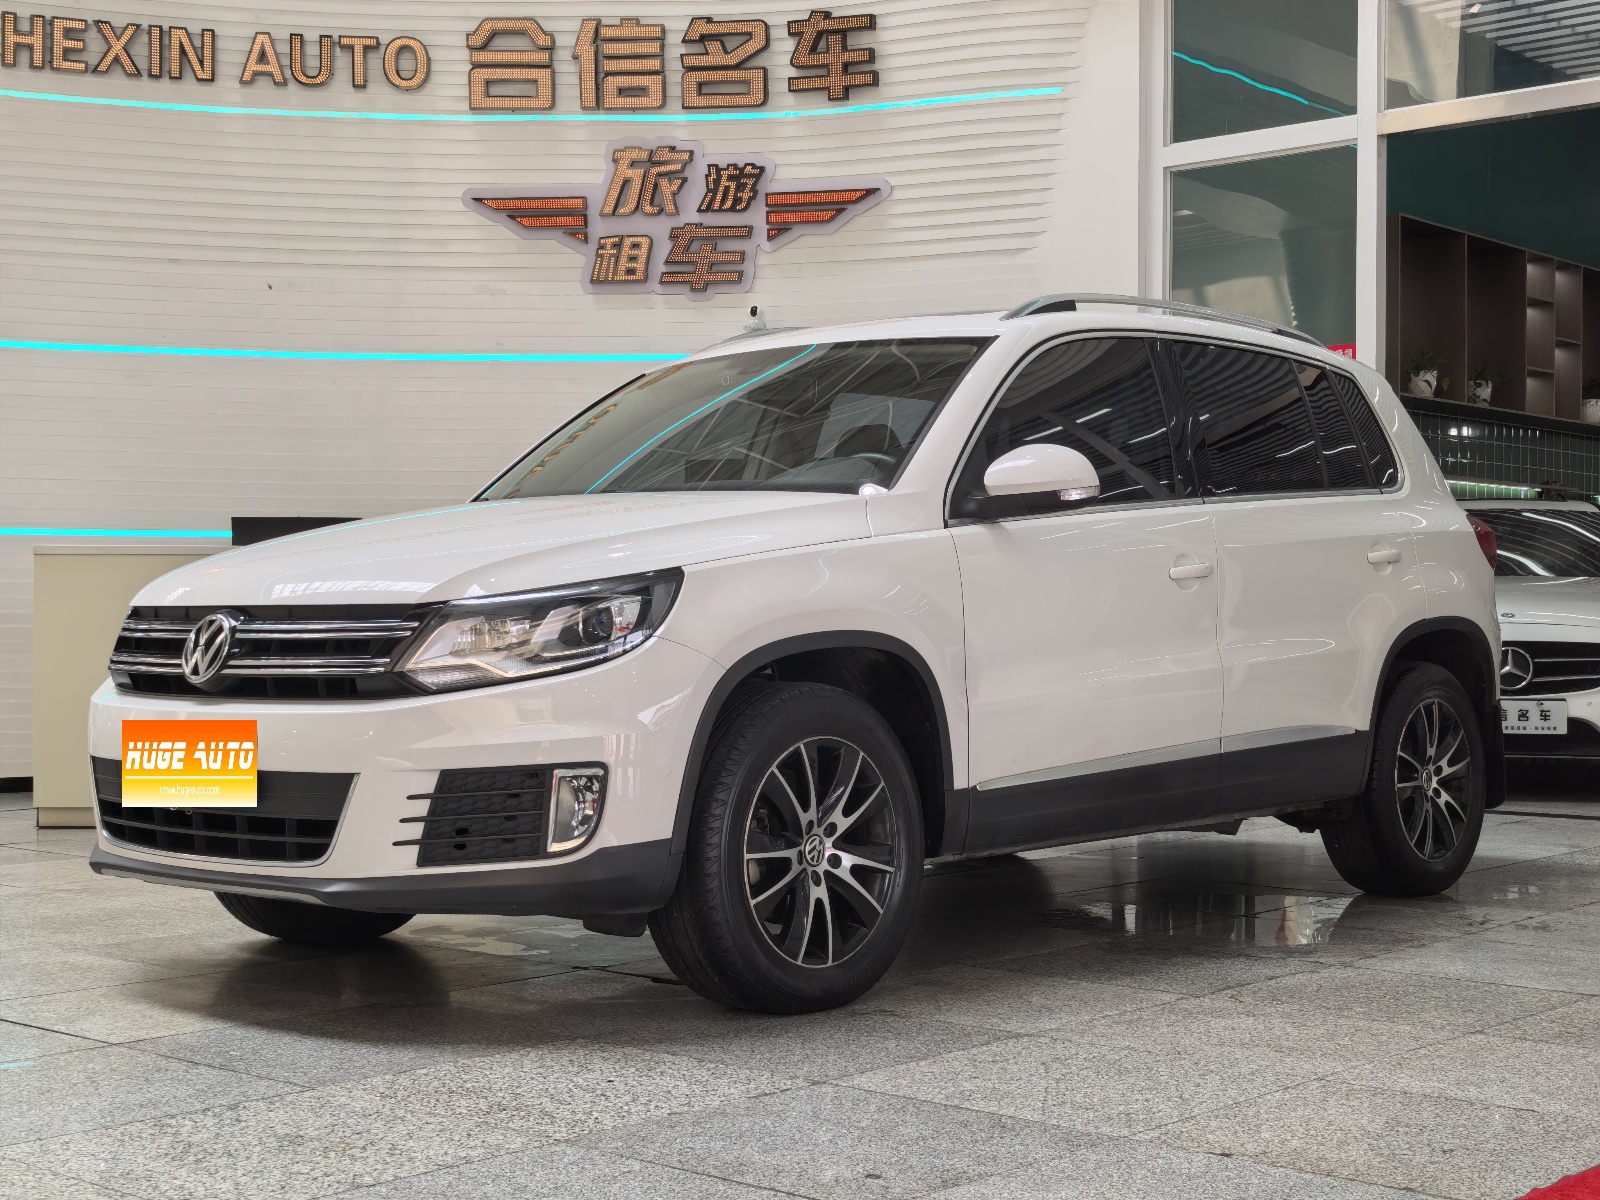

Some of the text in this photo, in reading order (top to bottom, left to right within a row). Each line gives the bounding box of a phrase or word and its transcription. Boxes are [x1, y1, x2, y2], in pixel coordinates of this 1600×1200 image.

[1, 11, 431, 91] HEXIN AUTO
[466, 10, 879, 111] 合信名车
[599, 146, 765, 217] 旅游
[590, 223, 753, 292] 租车
